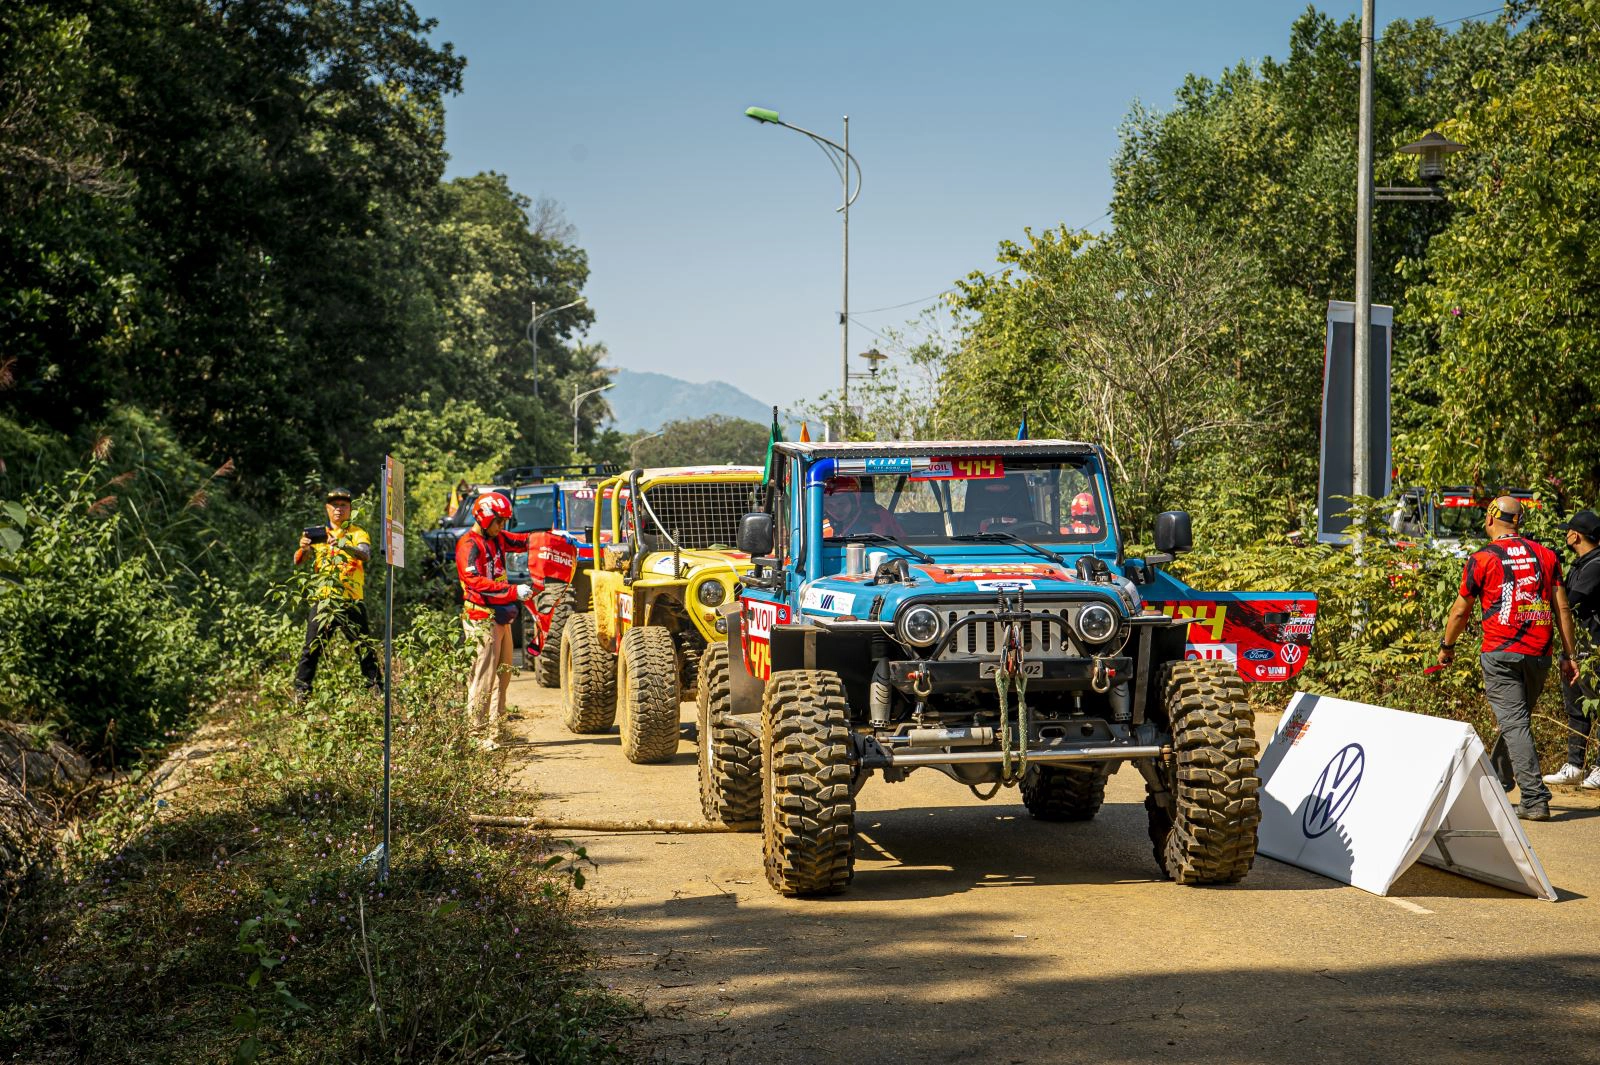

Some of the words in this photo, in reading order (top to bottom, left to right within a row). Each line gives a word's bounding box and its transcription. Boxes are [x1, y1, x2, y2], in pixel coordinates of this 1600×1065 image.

[928, 463, 949, 471] VOIL
[959, 460, 995, 476] 414
[575, 490, 594, 499] 411
[1507, 546, 1527, 557] 404
[1249, 648, 1269, 660] Ford
